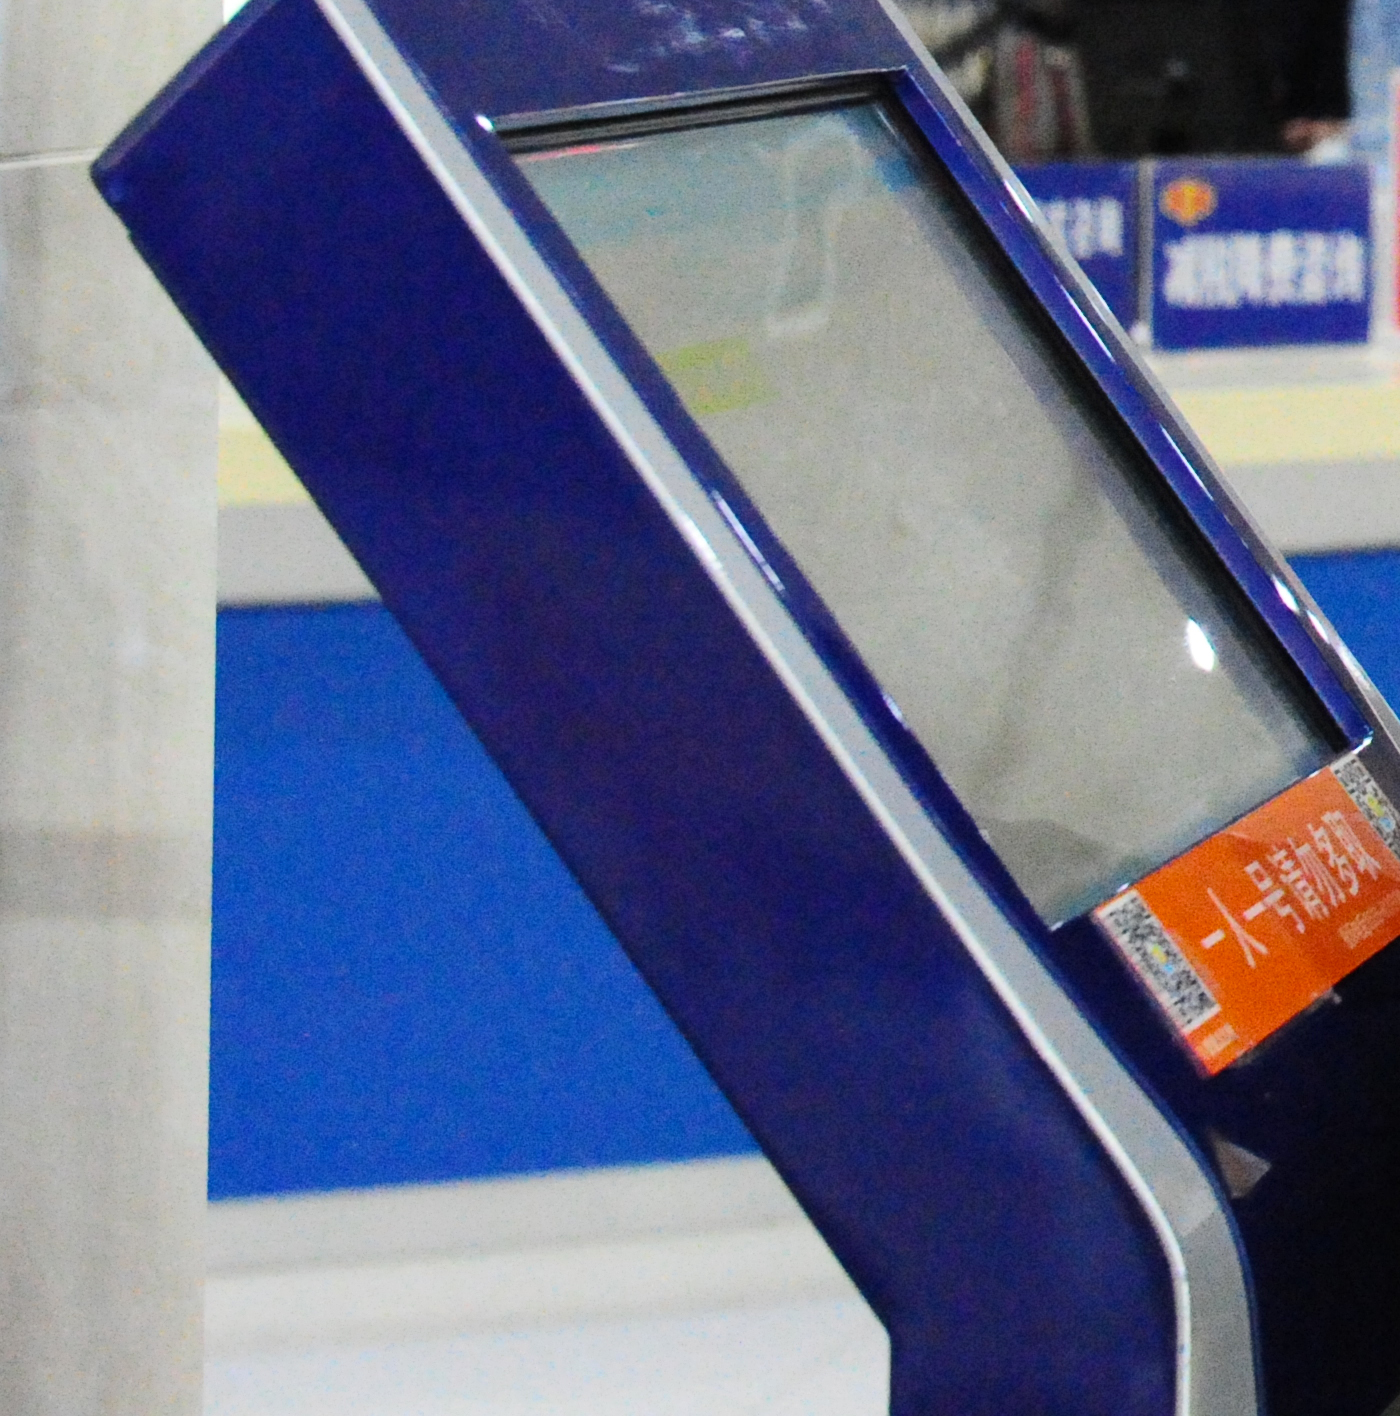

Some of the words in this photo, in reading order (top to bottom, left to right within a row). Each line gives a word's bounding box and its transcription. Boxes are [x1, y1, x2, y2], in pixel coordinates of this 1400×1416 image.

[1201, 810, 1382, 969] 一人一号请勿多取
